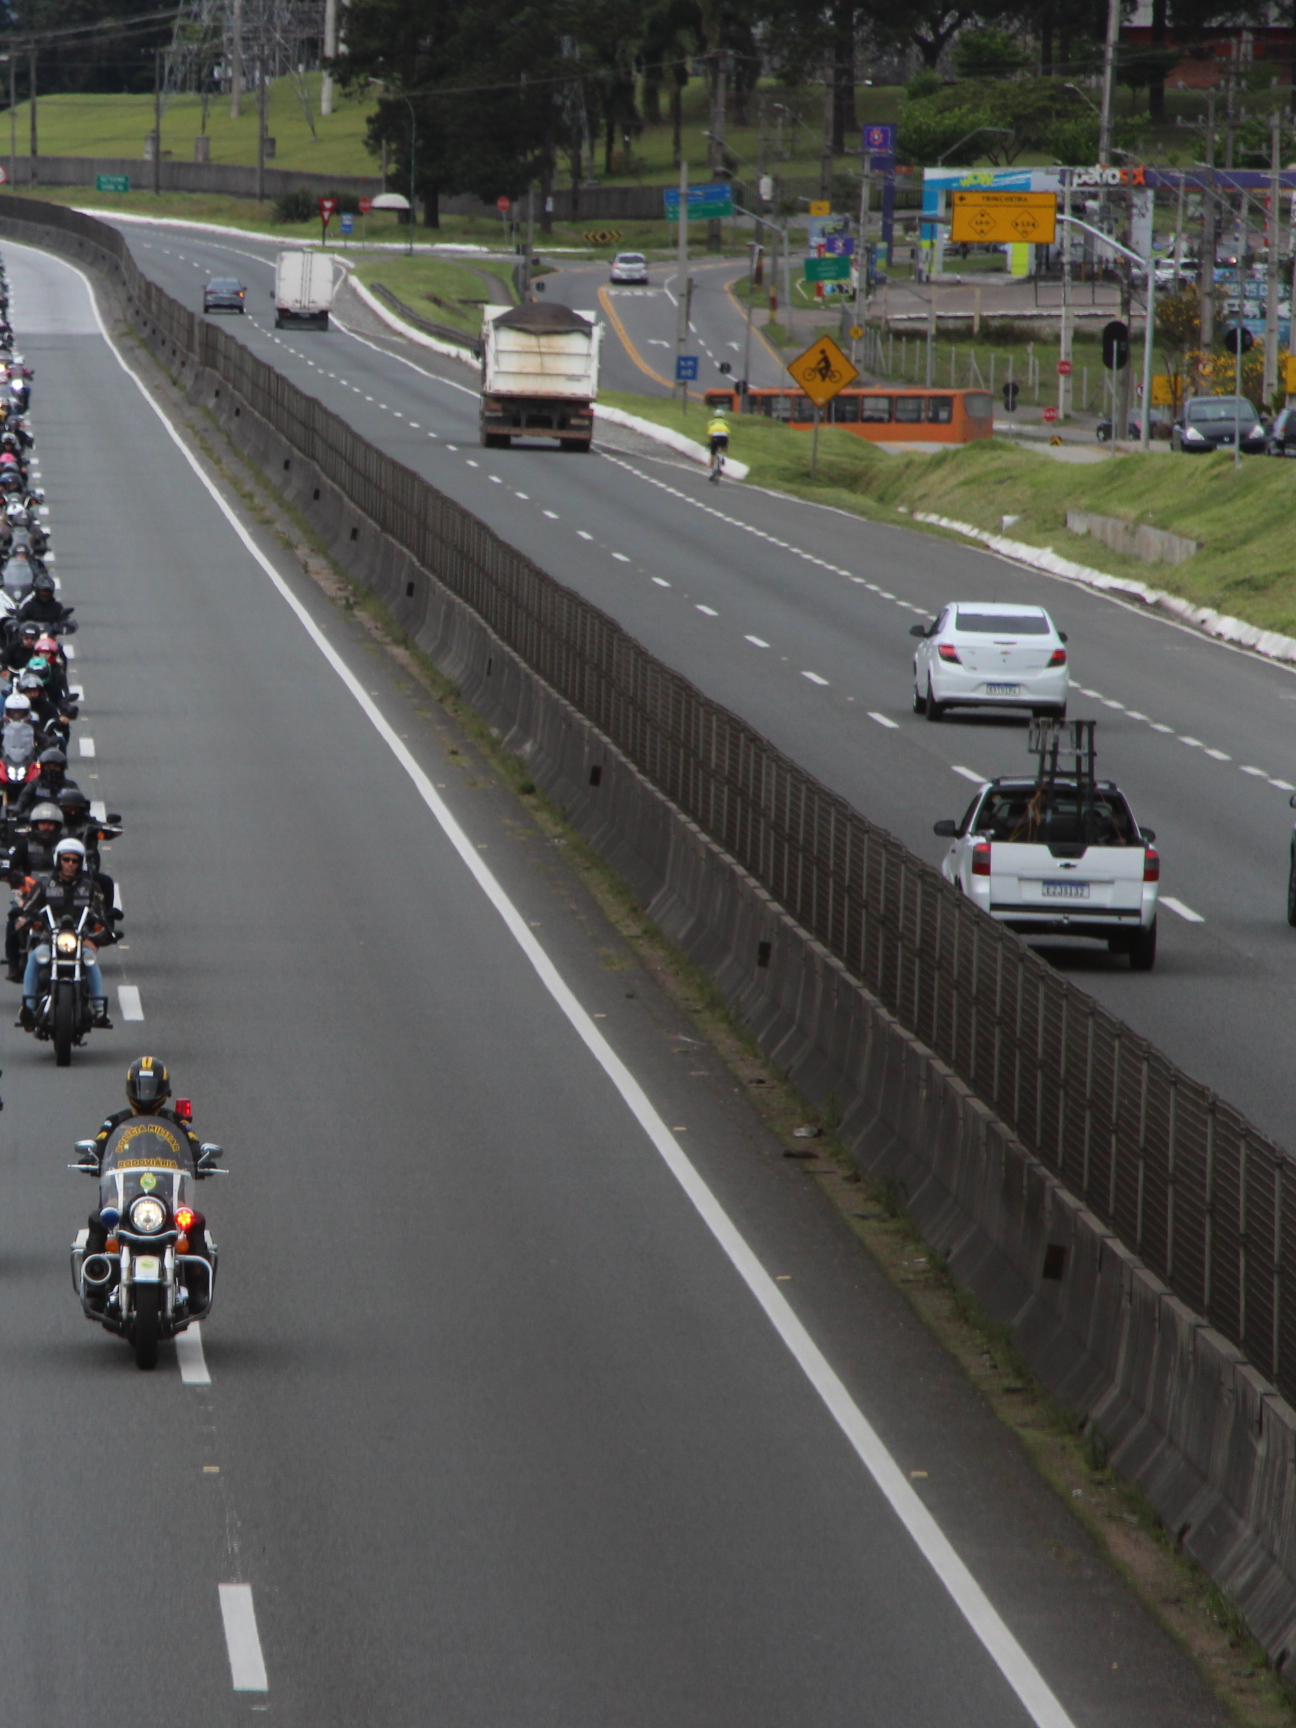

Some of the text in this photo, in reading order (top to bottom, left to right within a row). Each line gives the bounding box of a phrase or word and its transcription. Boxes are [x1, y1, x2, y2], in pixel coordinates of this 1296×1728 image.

[982, 195, 1028, 203] TRINCHEIRA
[115, 1124, 181, 1153] POLÍCIA MILITAR
[117, 1157, 179, 1169] RODOVIÁRIA
